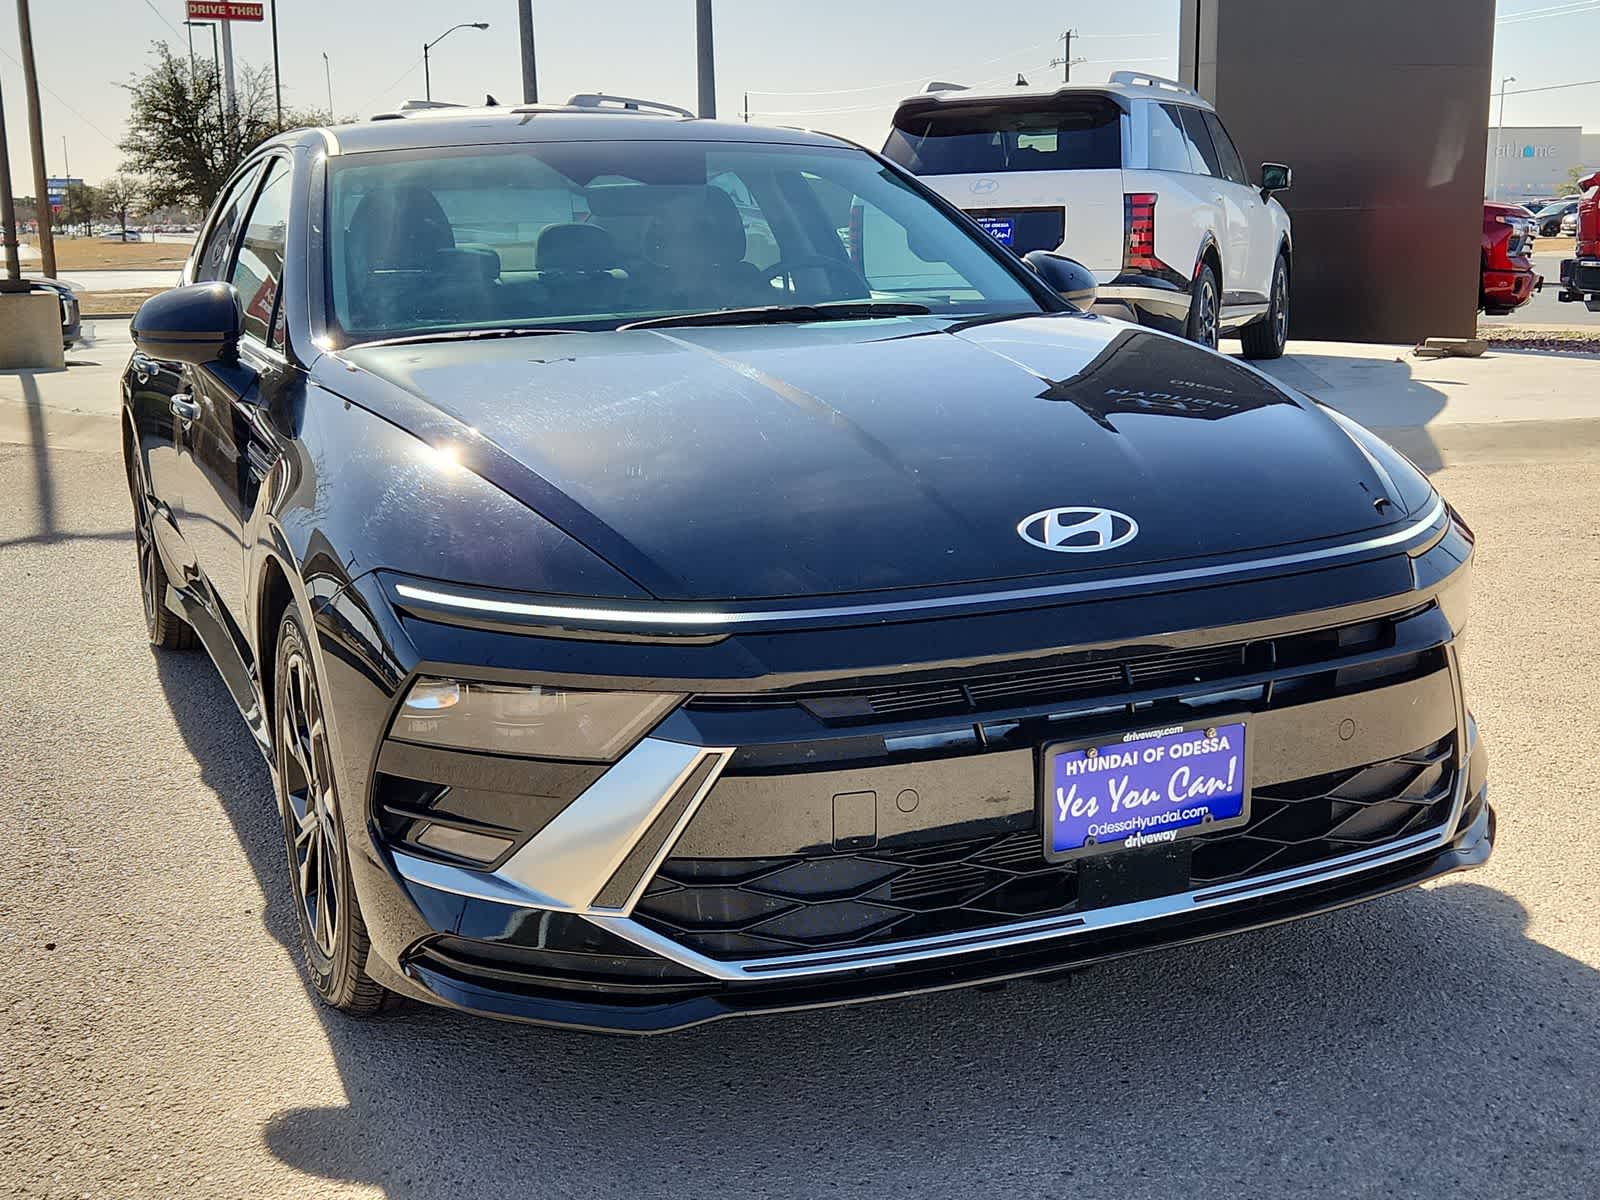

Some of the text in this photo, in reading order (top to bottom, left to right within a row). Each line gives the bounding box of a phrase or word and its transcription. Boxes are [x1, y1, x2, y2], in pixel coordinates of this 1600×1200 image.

[190, 4, 262, 16] DRIVE THRU
[1123, 725, 1184, 743] driveway.com
[1066, 736, 1230, 776] HYUNDAI OF ODESSA
[1056, 756, 1237, 822] Yes You Can!
[1088, 805, 1208, 837] OdessaHyundai.com
[1124, 829, 1177, 849] driveway
